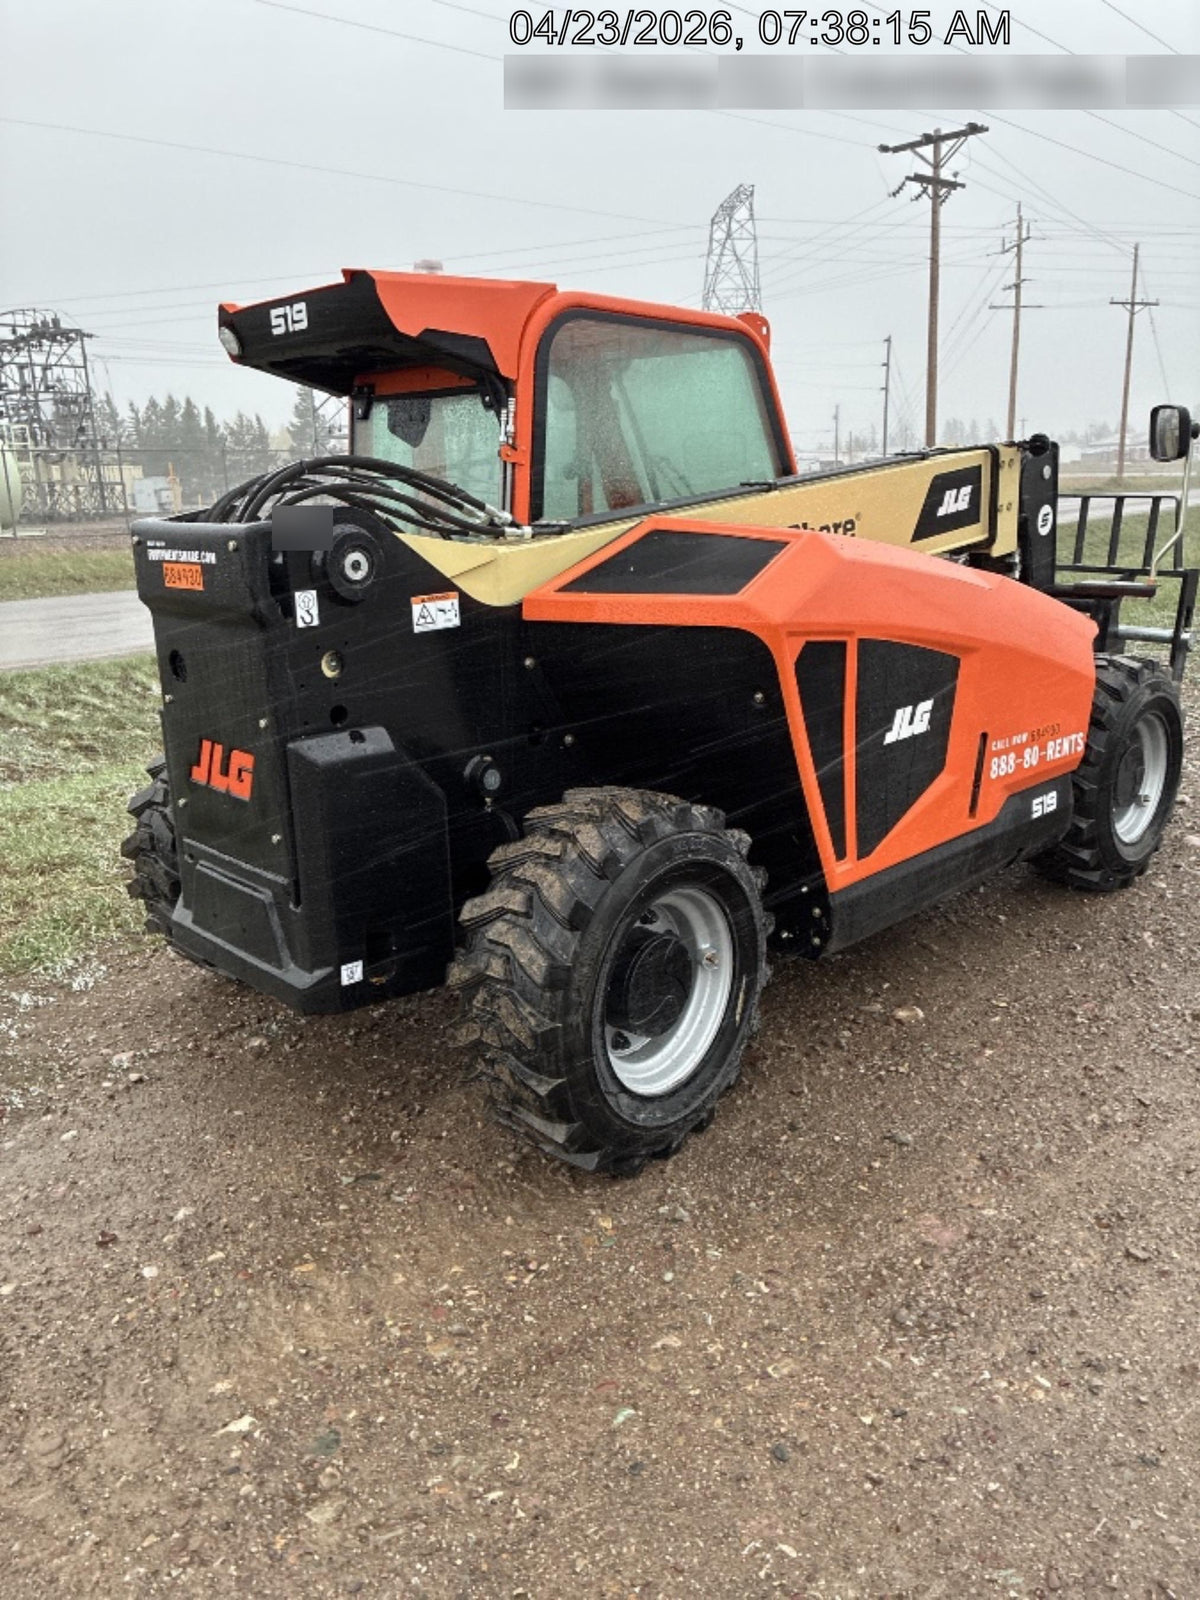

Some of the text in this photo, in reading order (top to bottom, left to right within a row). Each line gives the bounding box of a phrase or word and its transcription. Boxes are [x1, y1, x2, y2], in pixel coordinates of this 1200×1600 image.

[269, 302, 308, 336] 519
[937, 485, 973, 516] JLG
[883, 698, 934, 745] JLG
[990, 732, 1085, 779] 888-80-RENTS
[991, 732, 1029, 751] CALL NOW
[190, 739, 255, 801] JLG
[1031, 790, 1057, 819] 519
